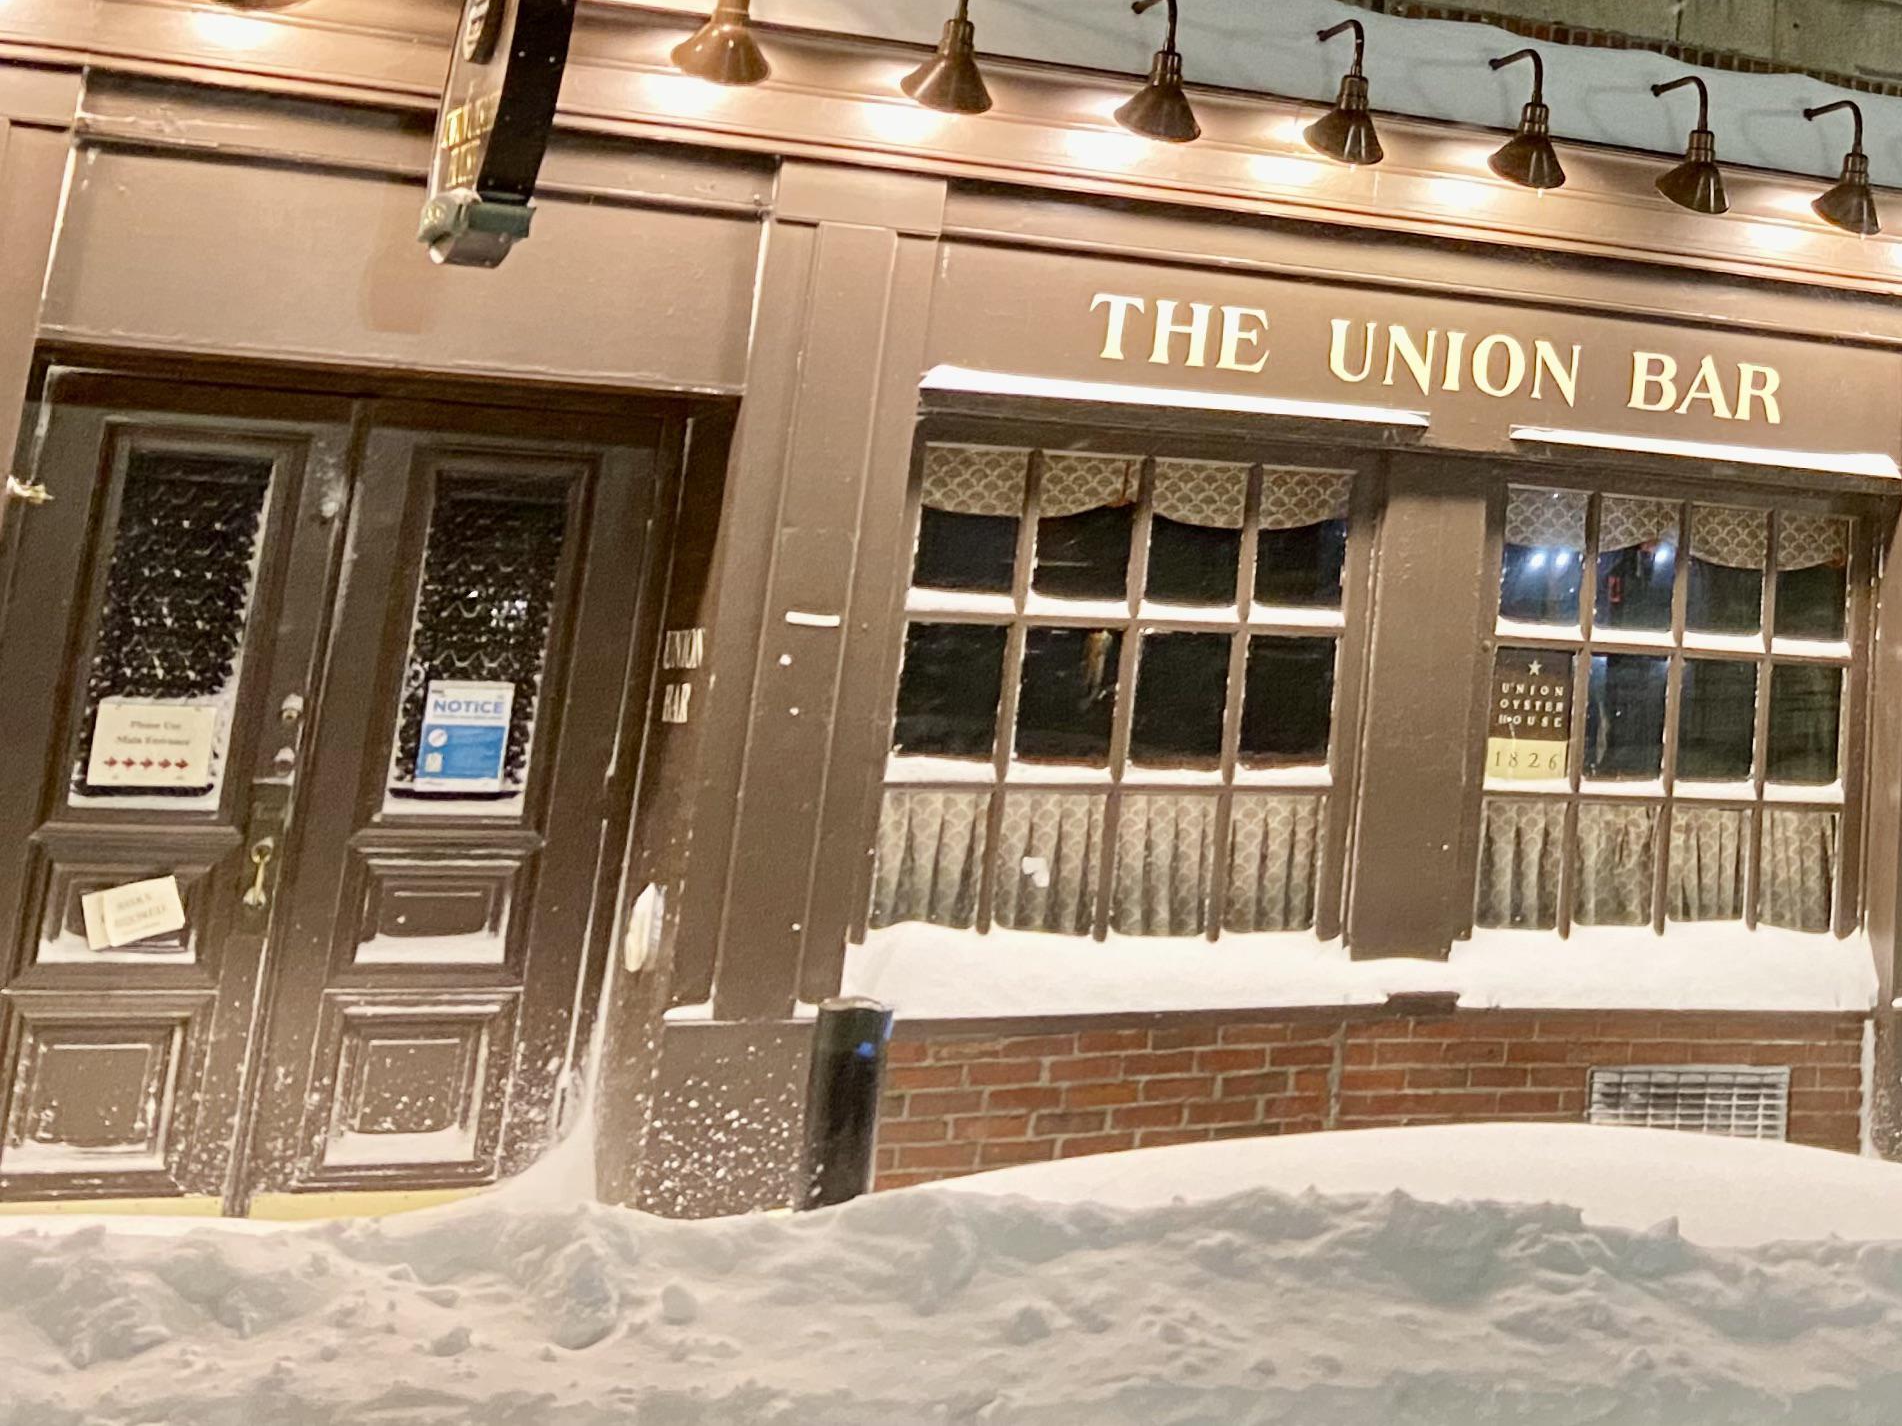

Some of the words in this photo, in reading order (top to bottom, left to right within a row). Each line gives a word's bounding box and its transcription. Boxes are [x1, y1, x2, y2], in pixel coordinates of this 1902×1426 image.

[1089, 292, 1271, 373] THE
[1329, 318, 1581, 408] UNION
[1626, 351, 1782, 424] BAR
[1502, 683, 1564, 697] UNION
[433, 700, 504, 714] NOTICE
[1500, 699, 1564, 712] OYSTER
[1498, 714, 1563, 728] HOUSE
[1494, 751, 1560, 770] 1826
